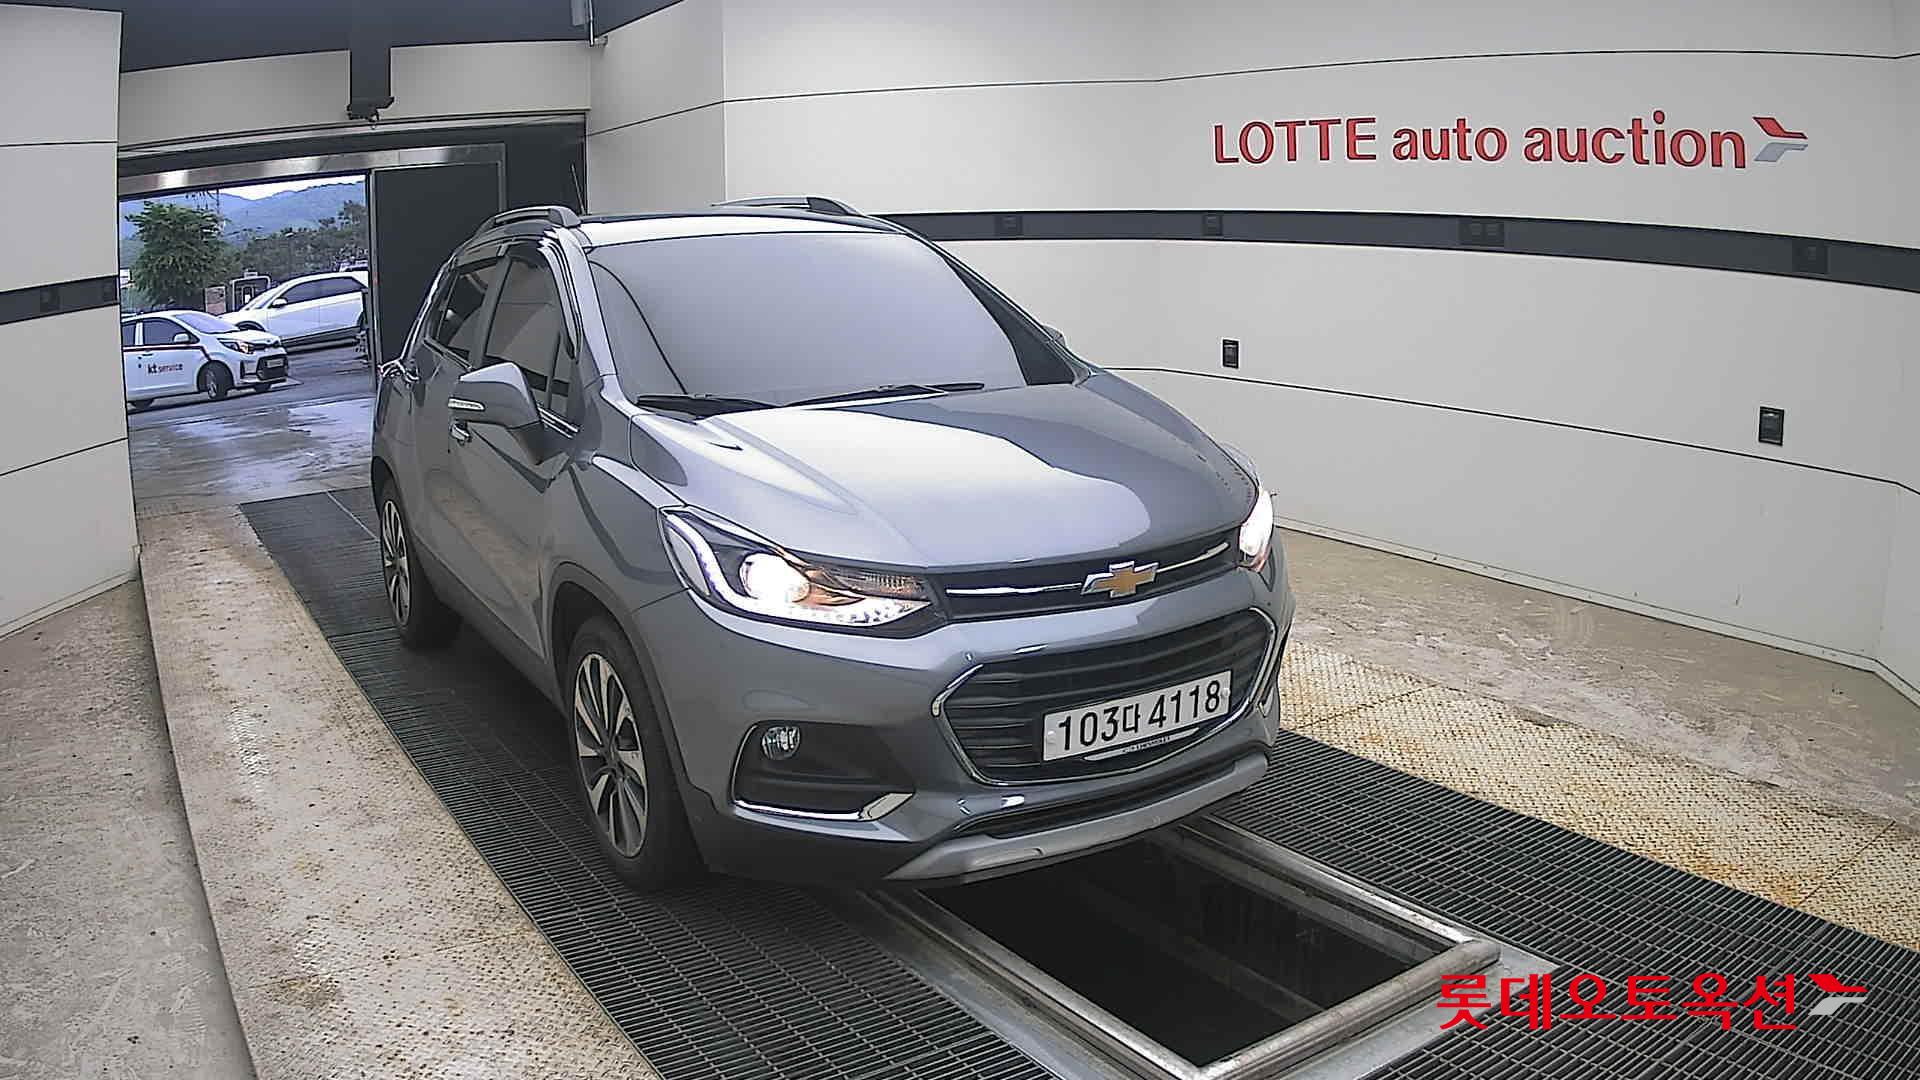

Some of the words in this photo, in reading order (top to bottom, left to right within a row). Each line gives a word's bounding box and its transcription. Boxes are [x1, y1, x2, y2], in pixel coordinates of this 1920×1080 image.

[1215, 118, 1376, 162] LOTTE
[1393, 118, 1509, 161] auto
[1523, 111, 1746, 167] auction
[147, 363, 157, 374] kt
[1058, 703, 1141, 751] 103다
[1148, 679, 1221, 728] 4118
